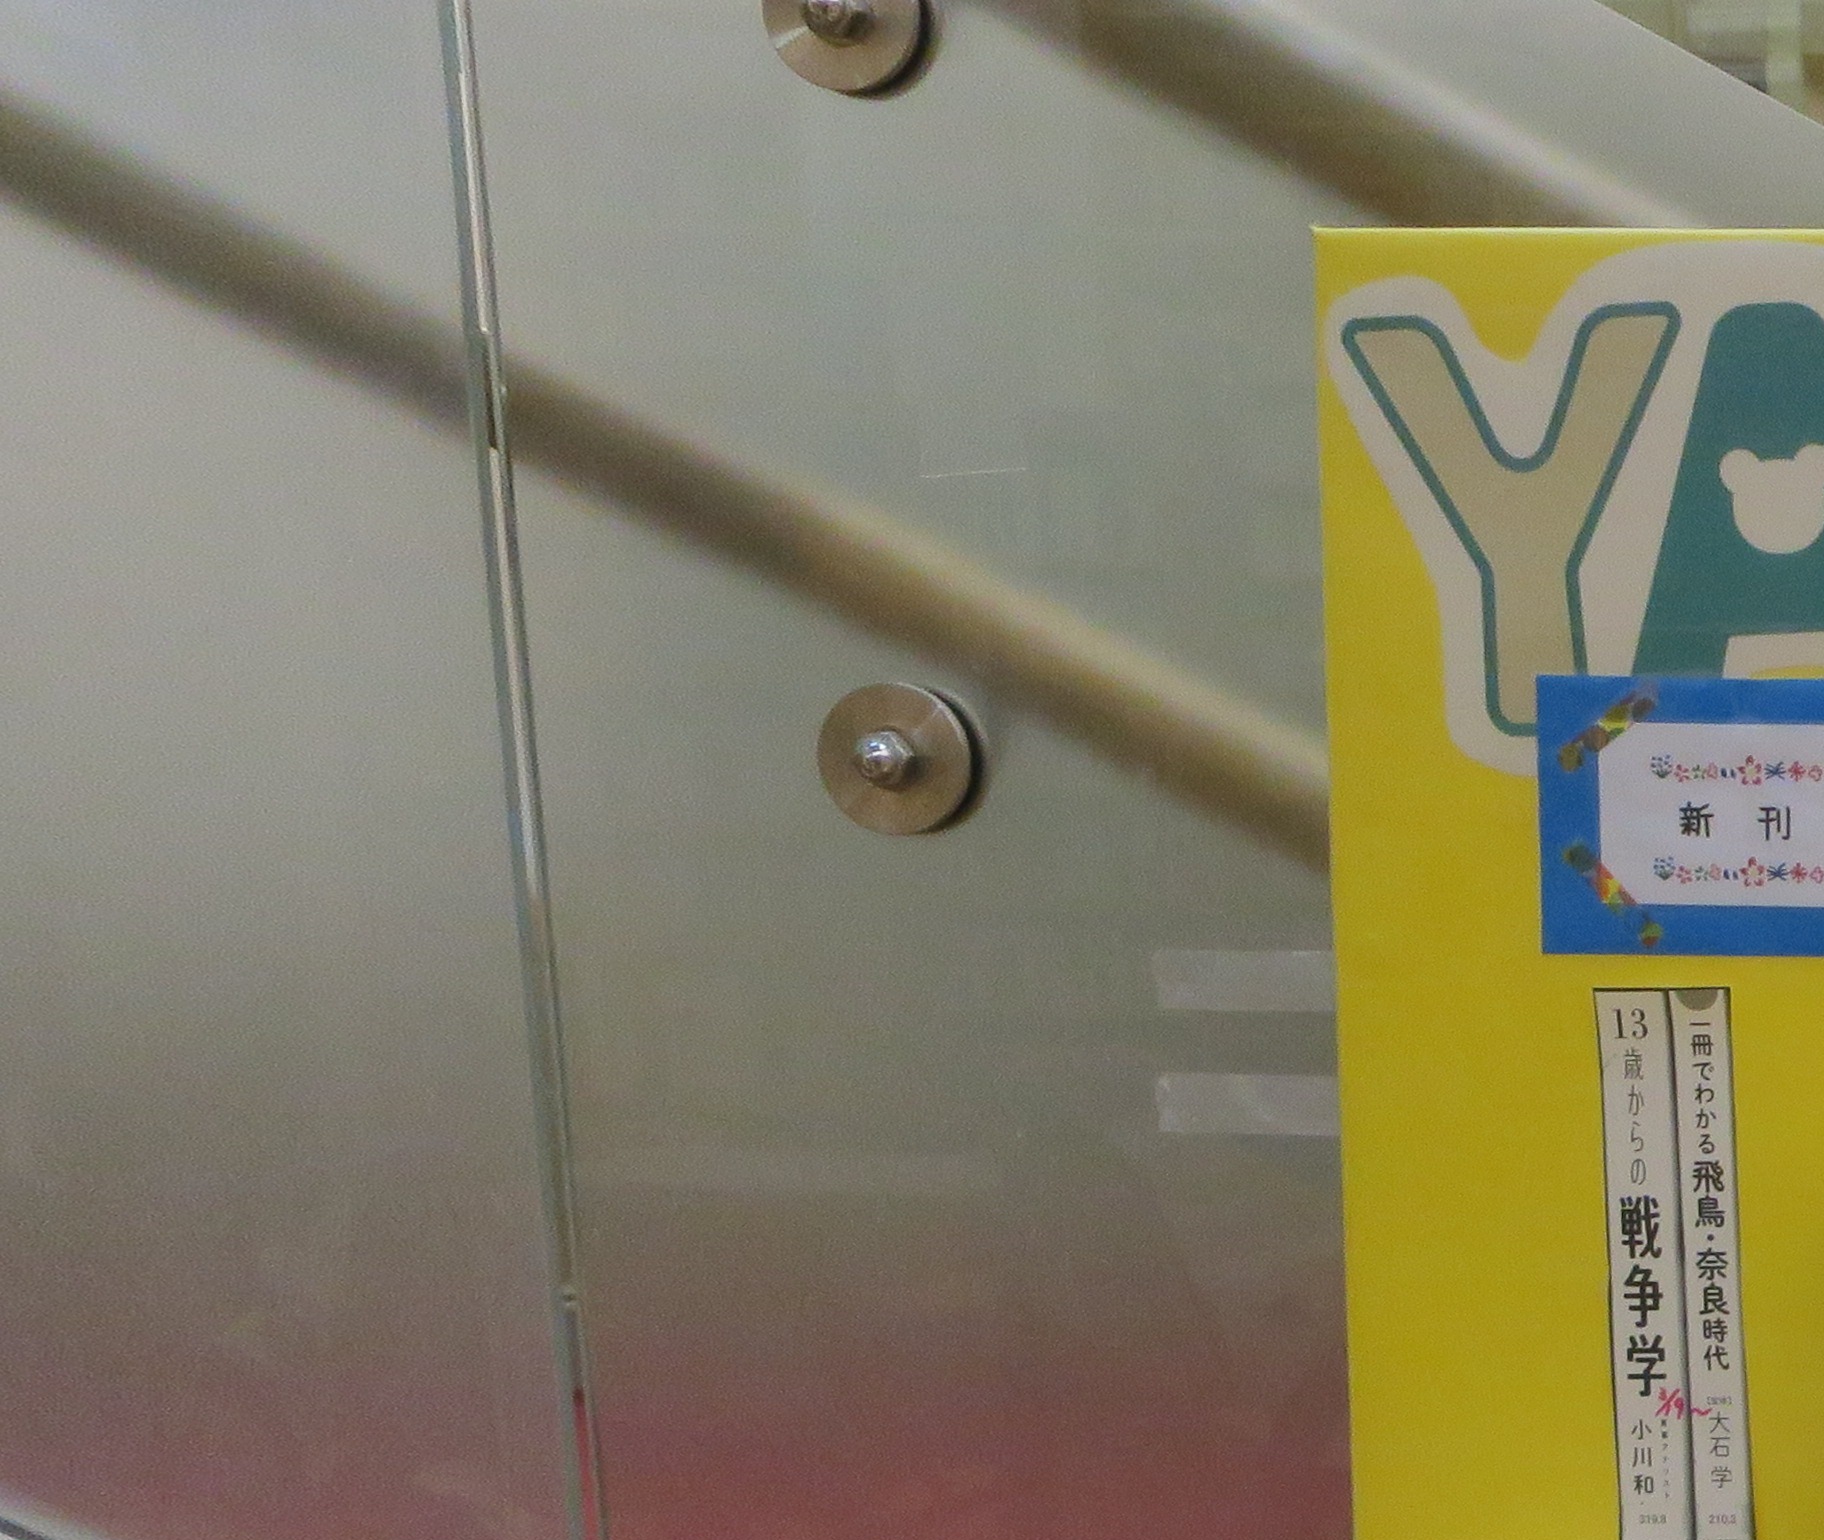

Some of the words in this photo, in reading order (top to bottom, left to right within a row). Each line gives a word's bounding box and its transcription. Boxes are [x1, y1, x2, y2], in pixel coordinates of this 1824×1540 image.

[1689, 1021, 1731, 1372] 一冊でわかる飛鳥・奈良時代
